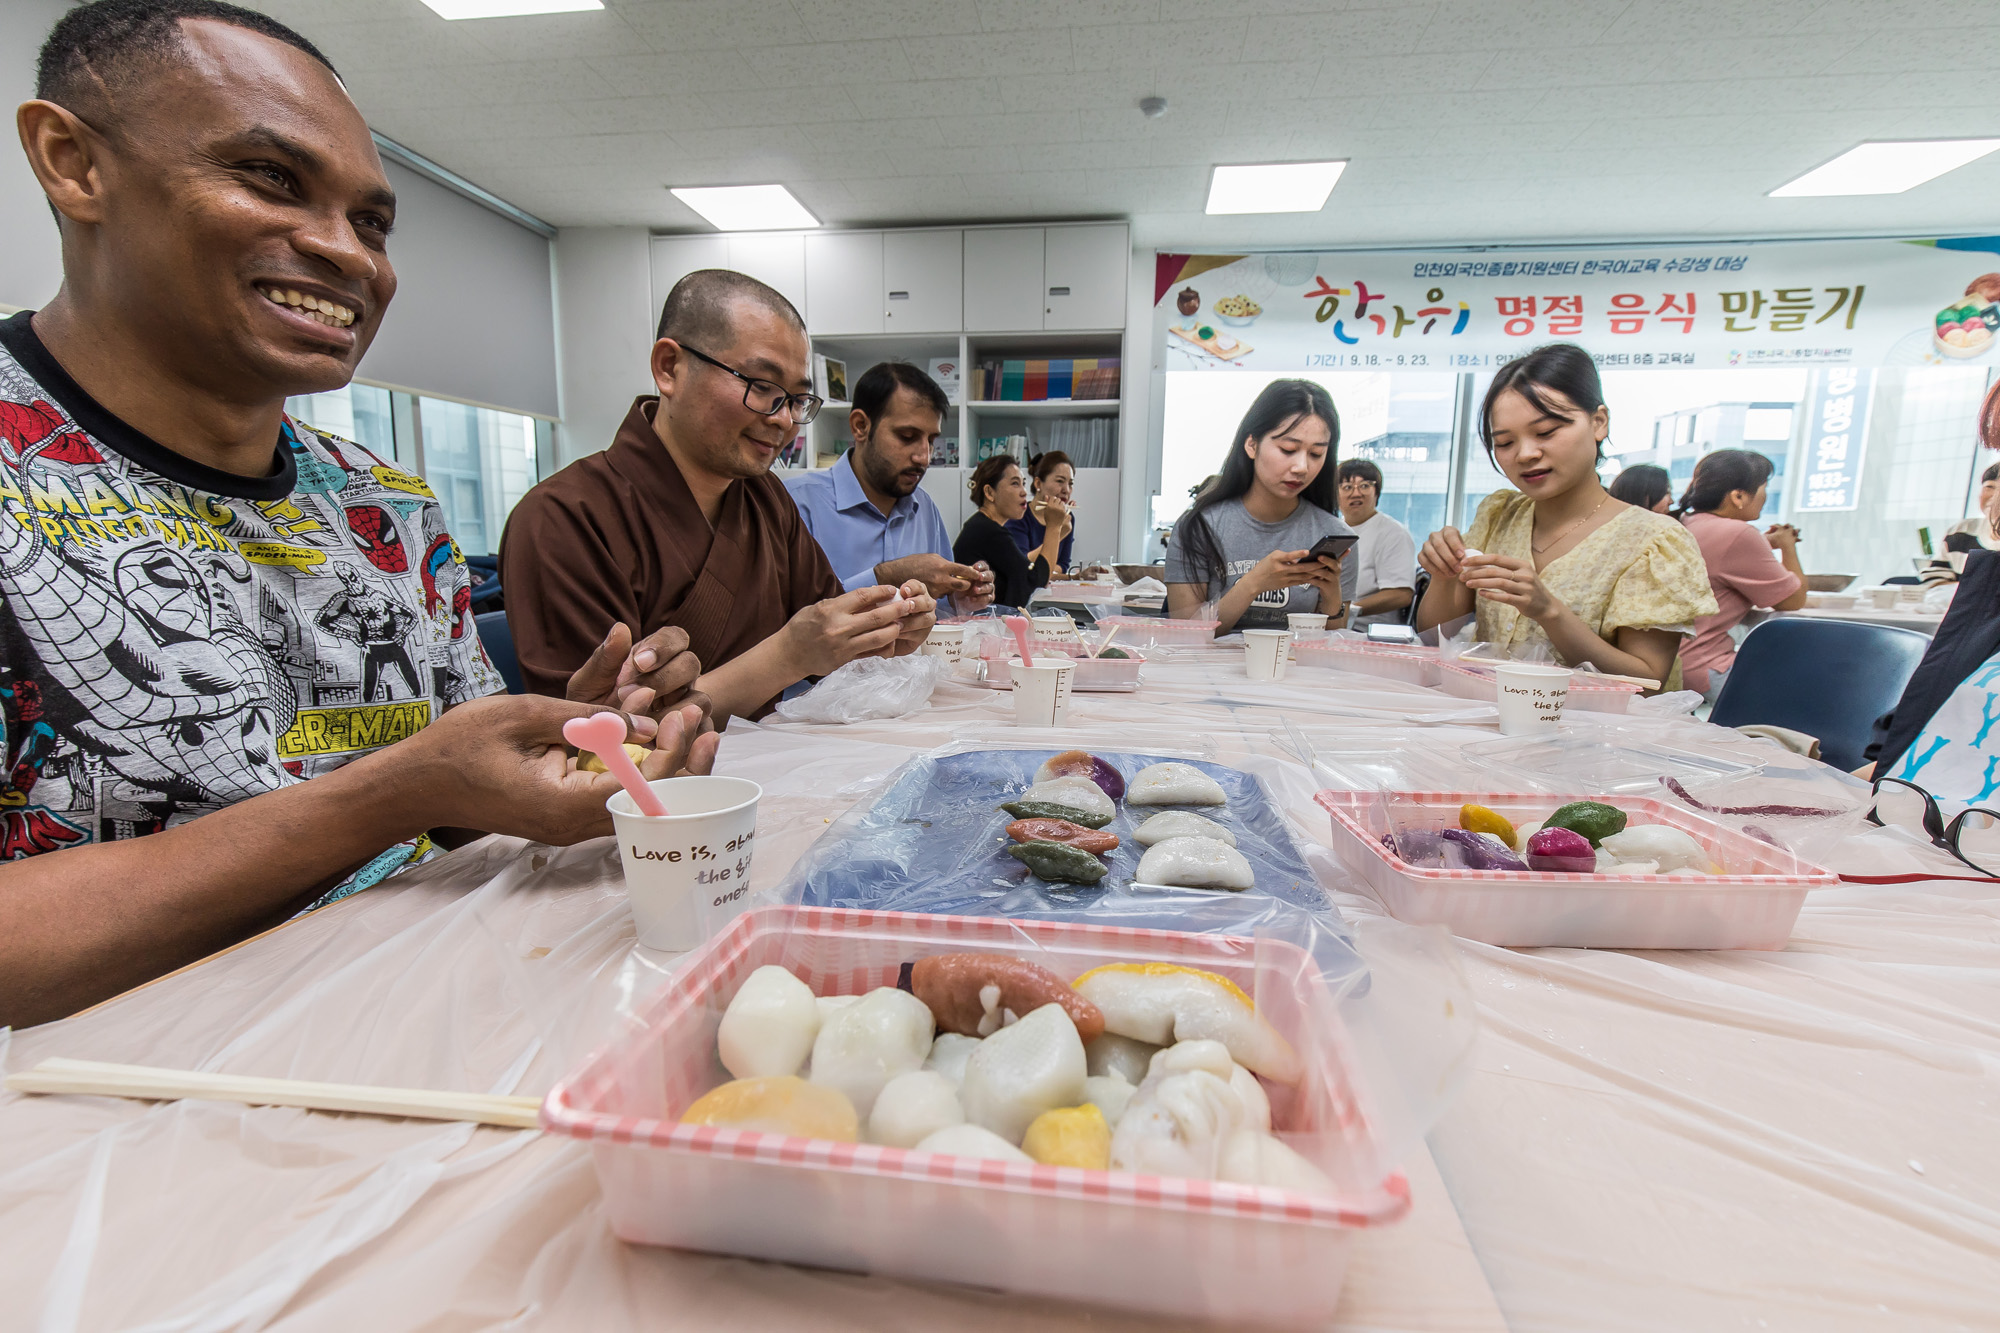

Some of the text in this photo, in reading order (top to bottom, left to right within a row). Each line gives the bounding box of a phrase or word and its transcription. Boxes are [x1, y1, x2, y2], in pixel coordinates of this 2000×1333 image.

[1413, 255, 1748, 277] 인천외국인종합지원센터 한국어교육 수강생 대상
[1304, 275, 1866, 344] 한가위 명절 음식 만들기
[1634, 353, 1653, 365] 8층
[1658, 352, 1695, 365] 교육실
[1504, 685, 1528, 696] Love
[1533, 688, 1546, 698] is,
[1533, 701, 1552, 710] the
[632, 845, 682, 863] Love
[690, 845, 717, 861] is,
[694, 868, 731, 885] the
